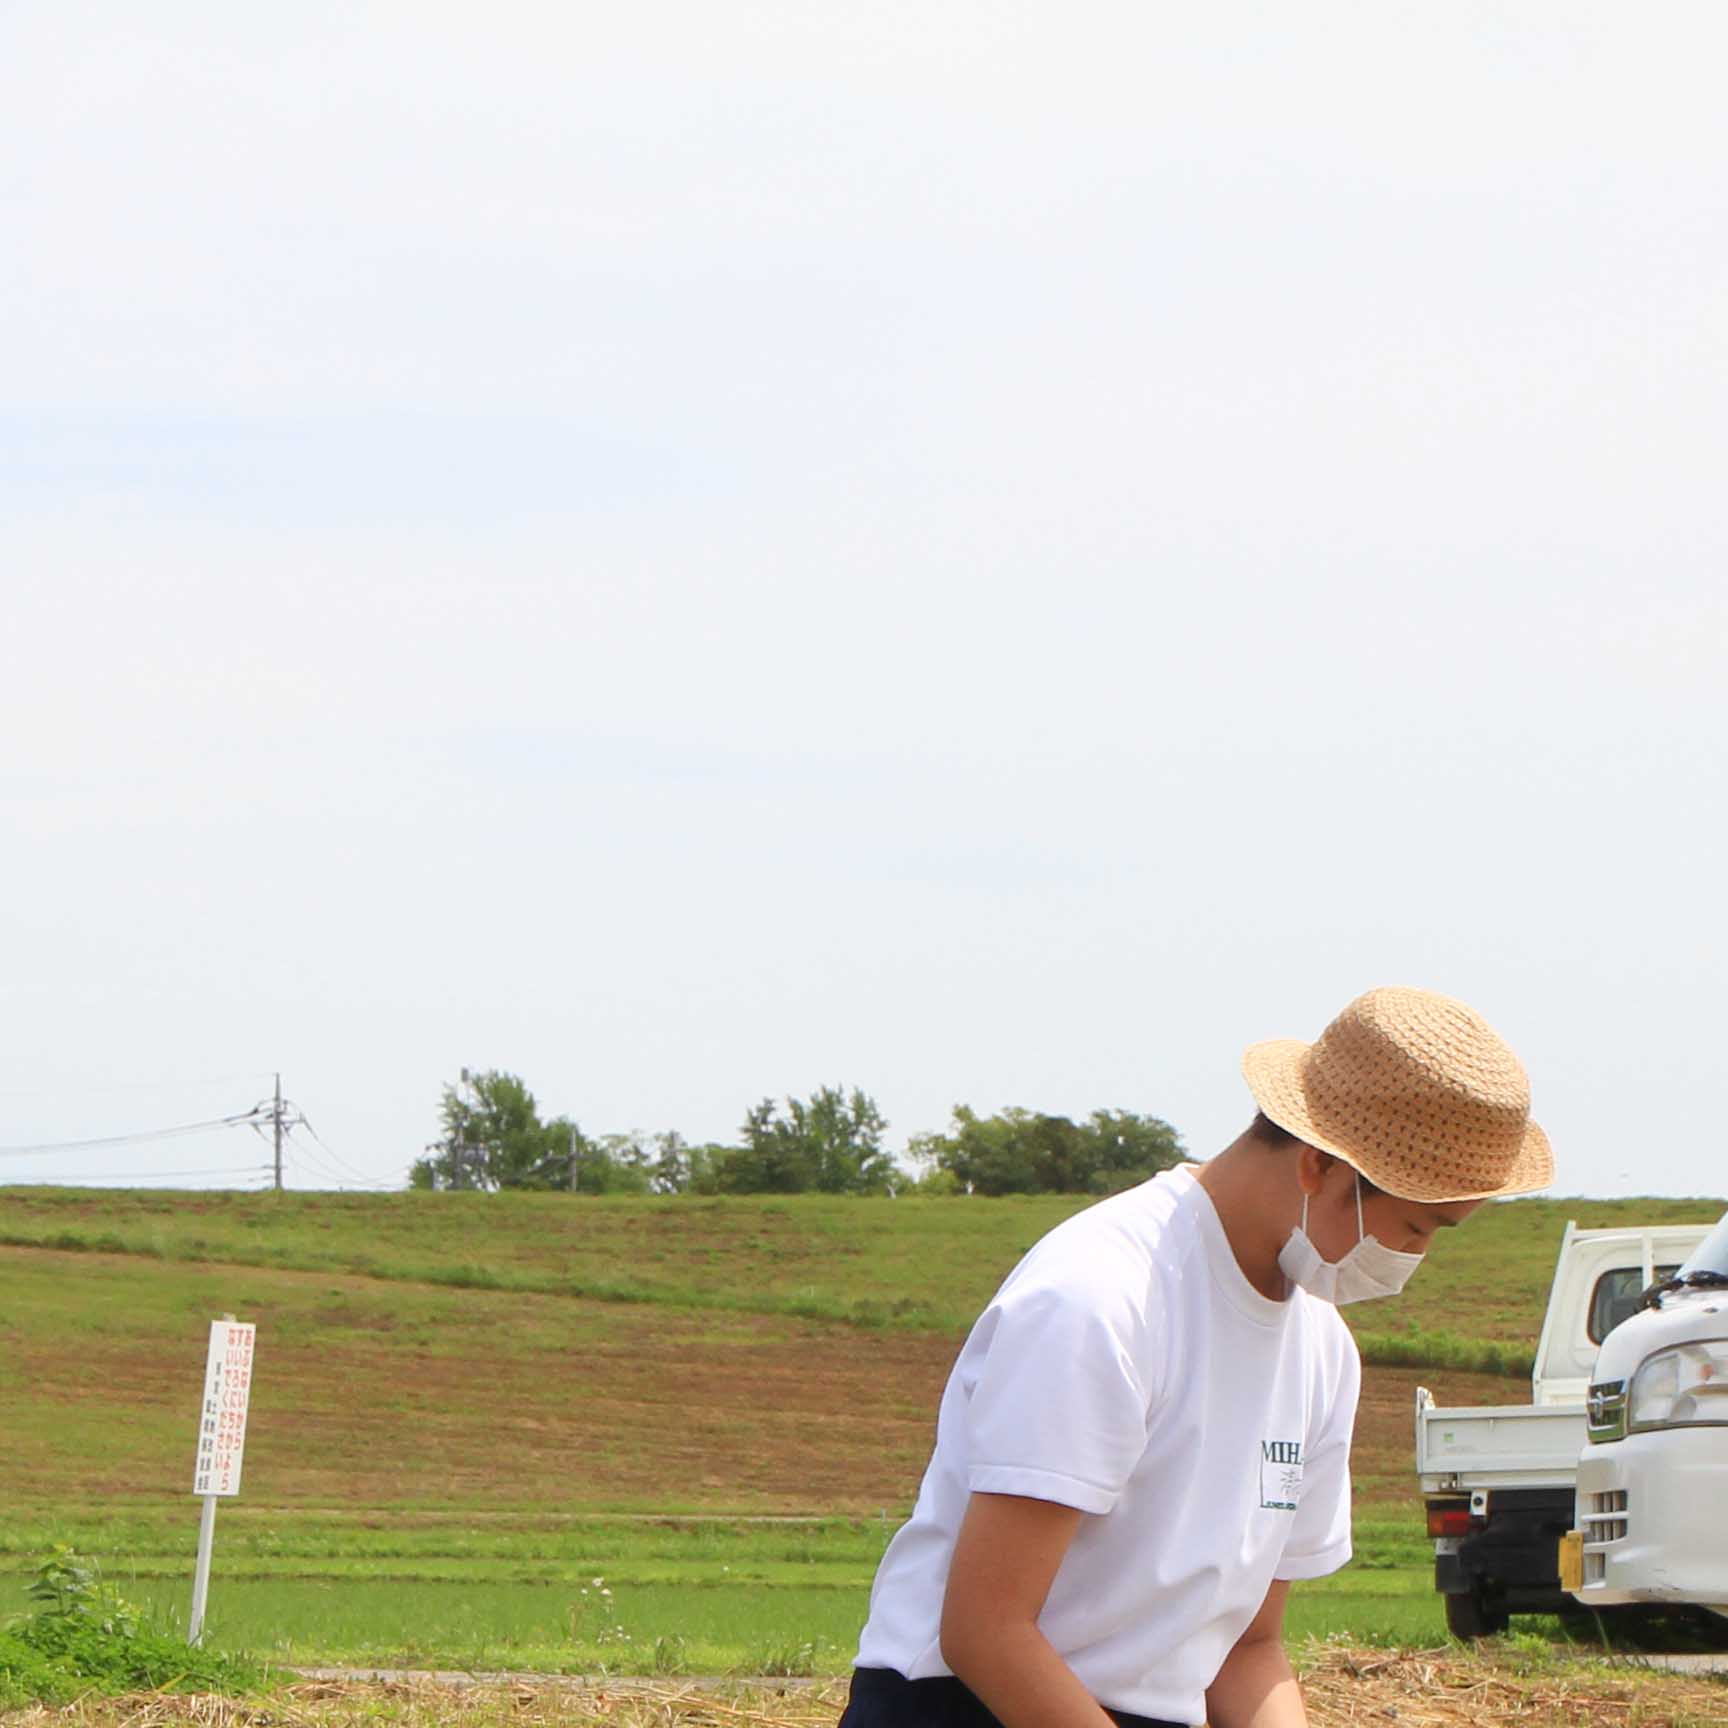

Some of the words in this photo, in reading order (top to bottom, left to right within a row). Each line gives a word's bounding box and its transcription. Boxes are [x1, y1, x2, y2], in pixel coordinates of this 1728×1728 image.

[215, 1328, 236, 1470] ないでください
[233, 1328, 252, 1450] あぶないから
[1261, 1440, 1304, 1465] MIH
